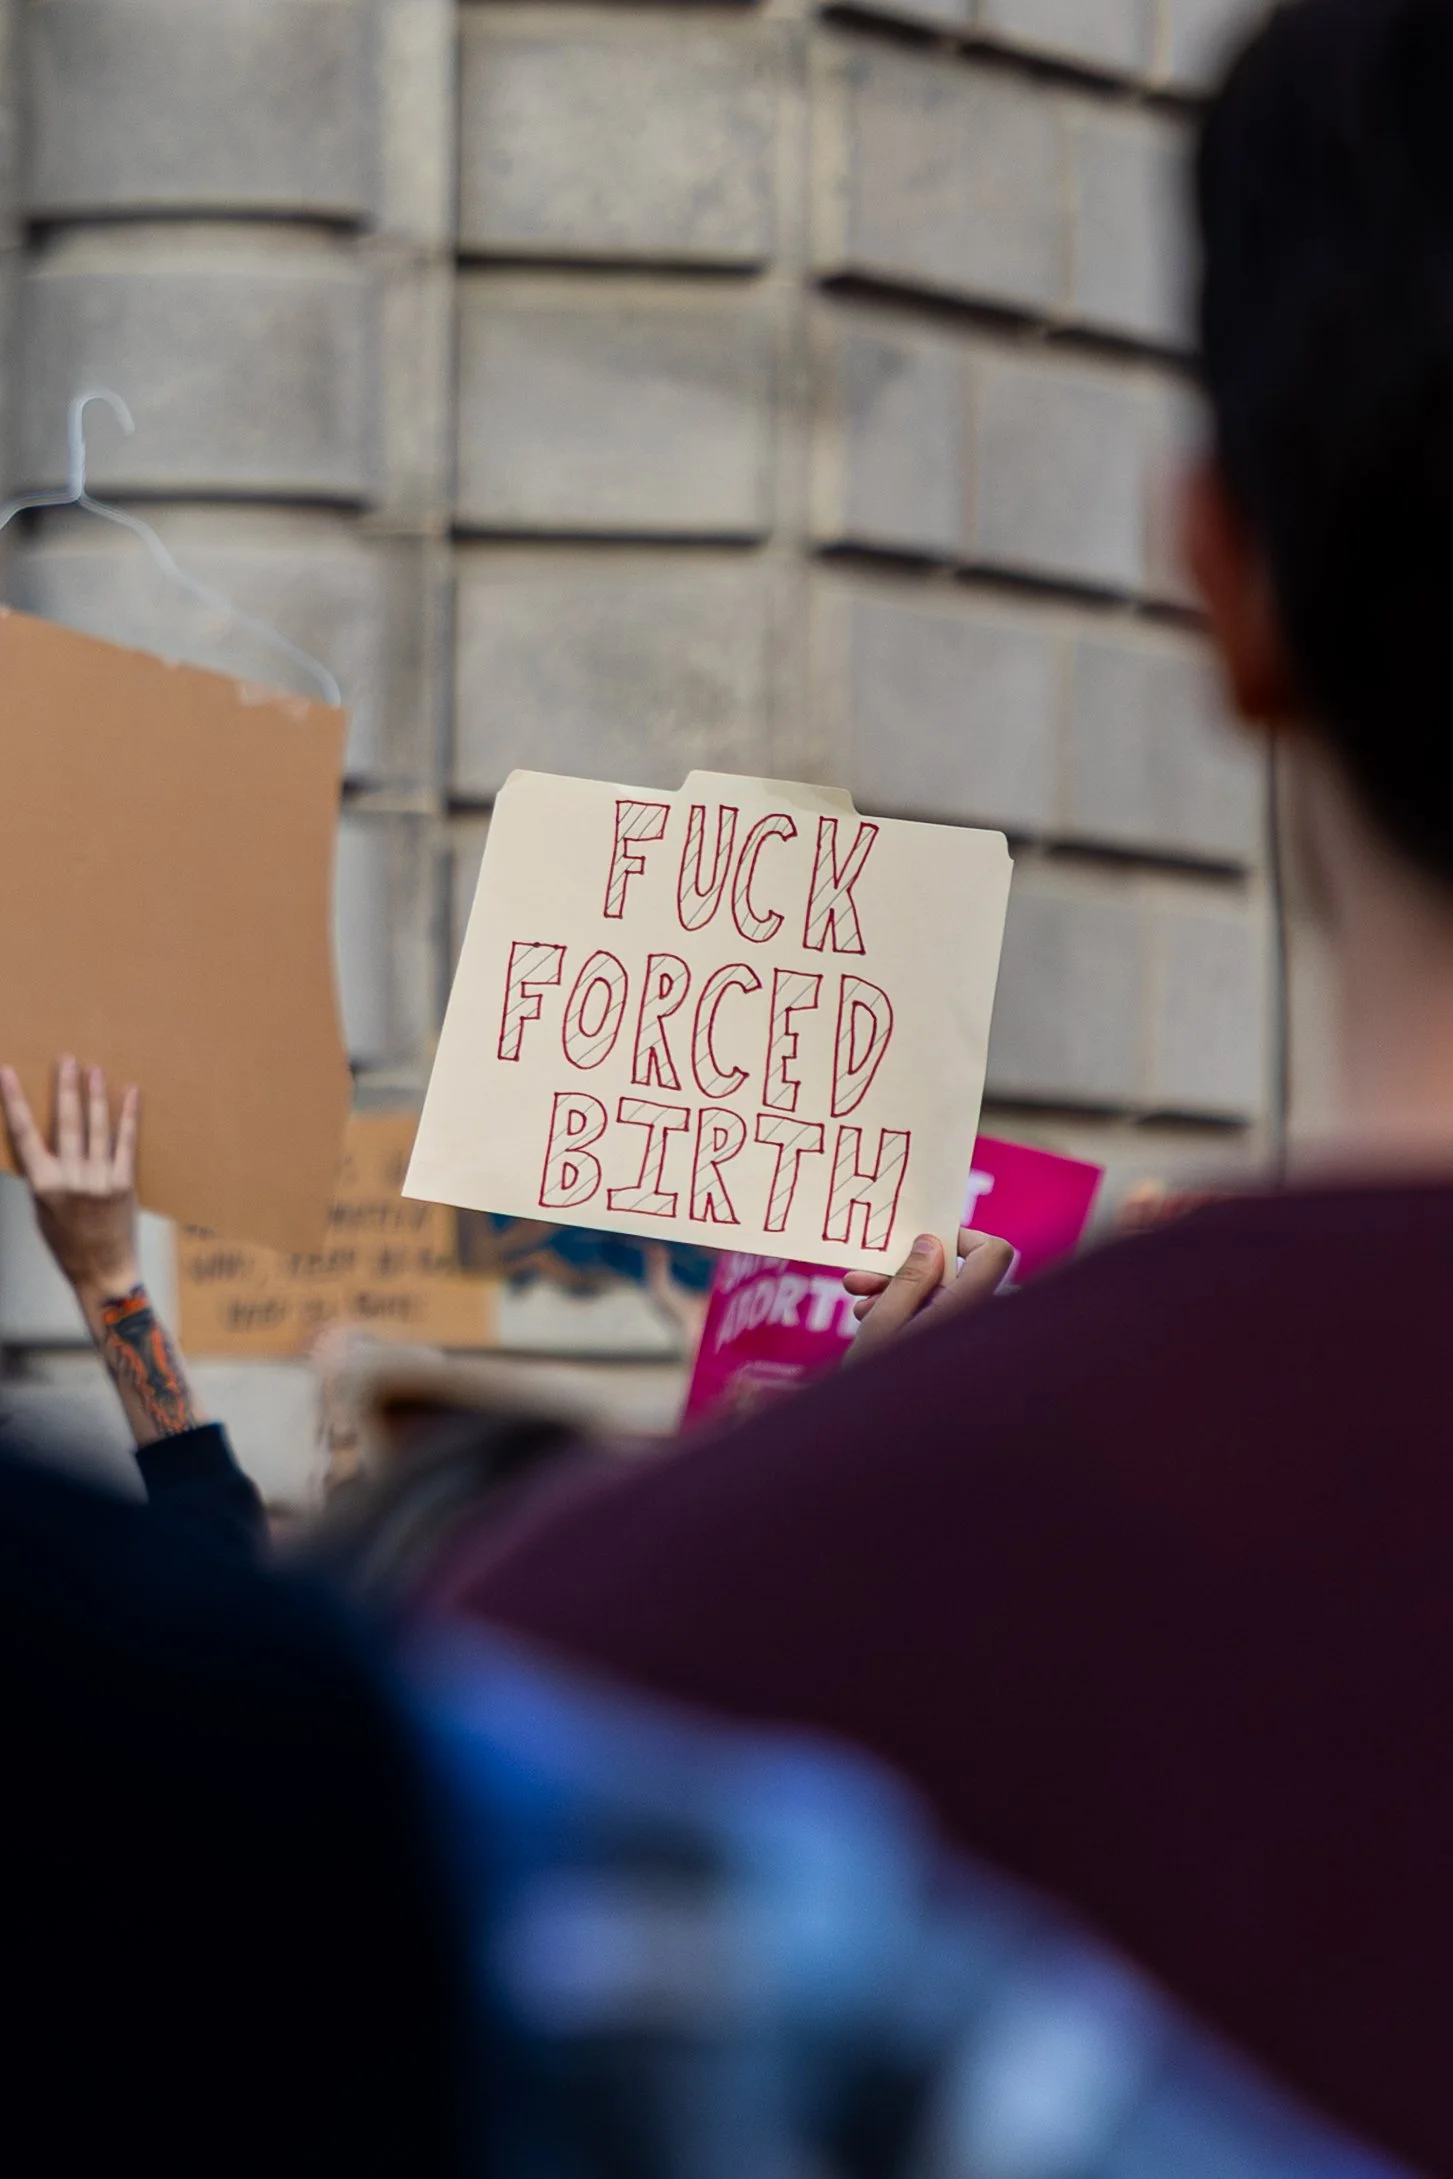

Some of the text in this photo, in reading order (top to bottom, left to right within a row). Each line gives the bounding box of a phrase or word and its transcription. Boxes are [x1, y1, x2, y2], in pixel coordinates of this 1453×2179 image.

[603, 799, 880, 955] FUCK
[497, 940, 895, 1119] FORCED
[537, 1091, 912, 1252] BIRTH
